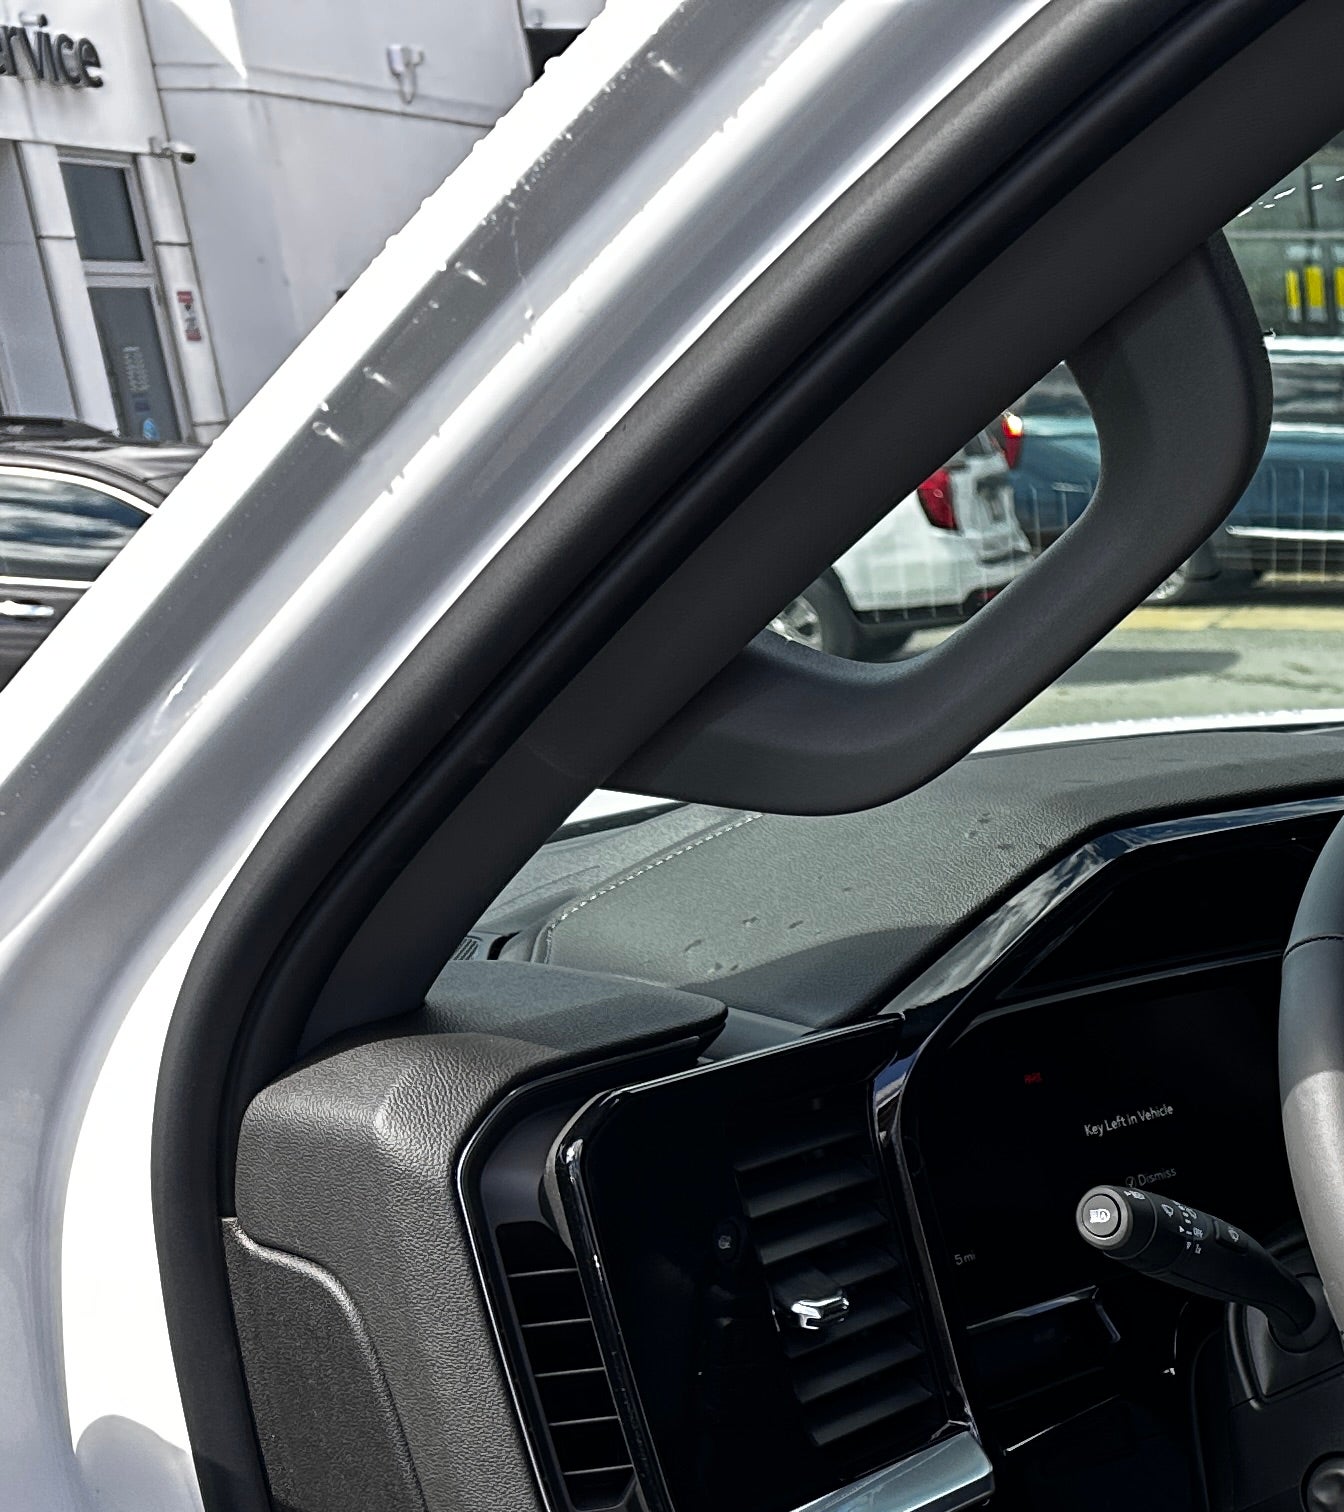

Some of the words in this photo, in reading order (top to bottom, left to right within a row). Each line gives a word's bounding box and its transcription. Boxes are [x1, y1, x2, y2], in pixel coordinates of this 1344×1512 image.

[0, 14, 103, 87] rvice
[1083, 1122, 1104, 1138] Key
[1104, 1114, 1127, 1132] Left
[1137, 1103, 1174, 1122] Vehicle
[1138, 1168, 1177, 1187] Dismiss
